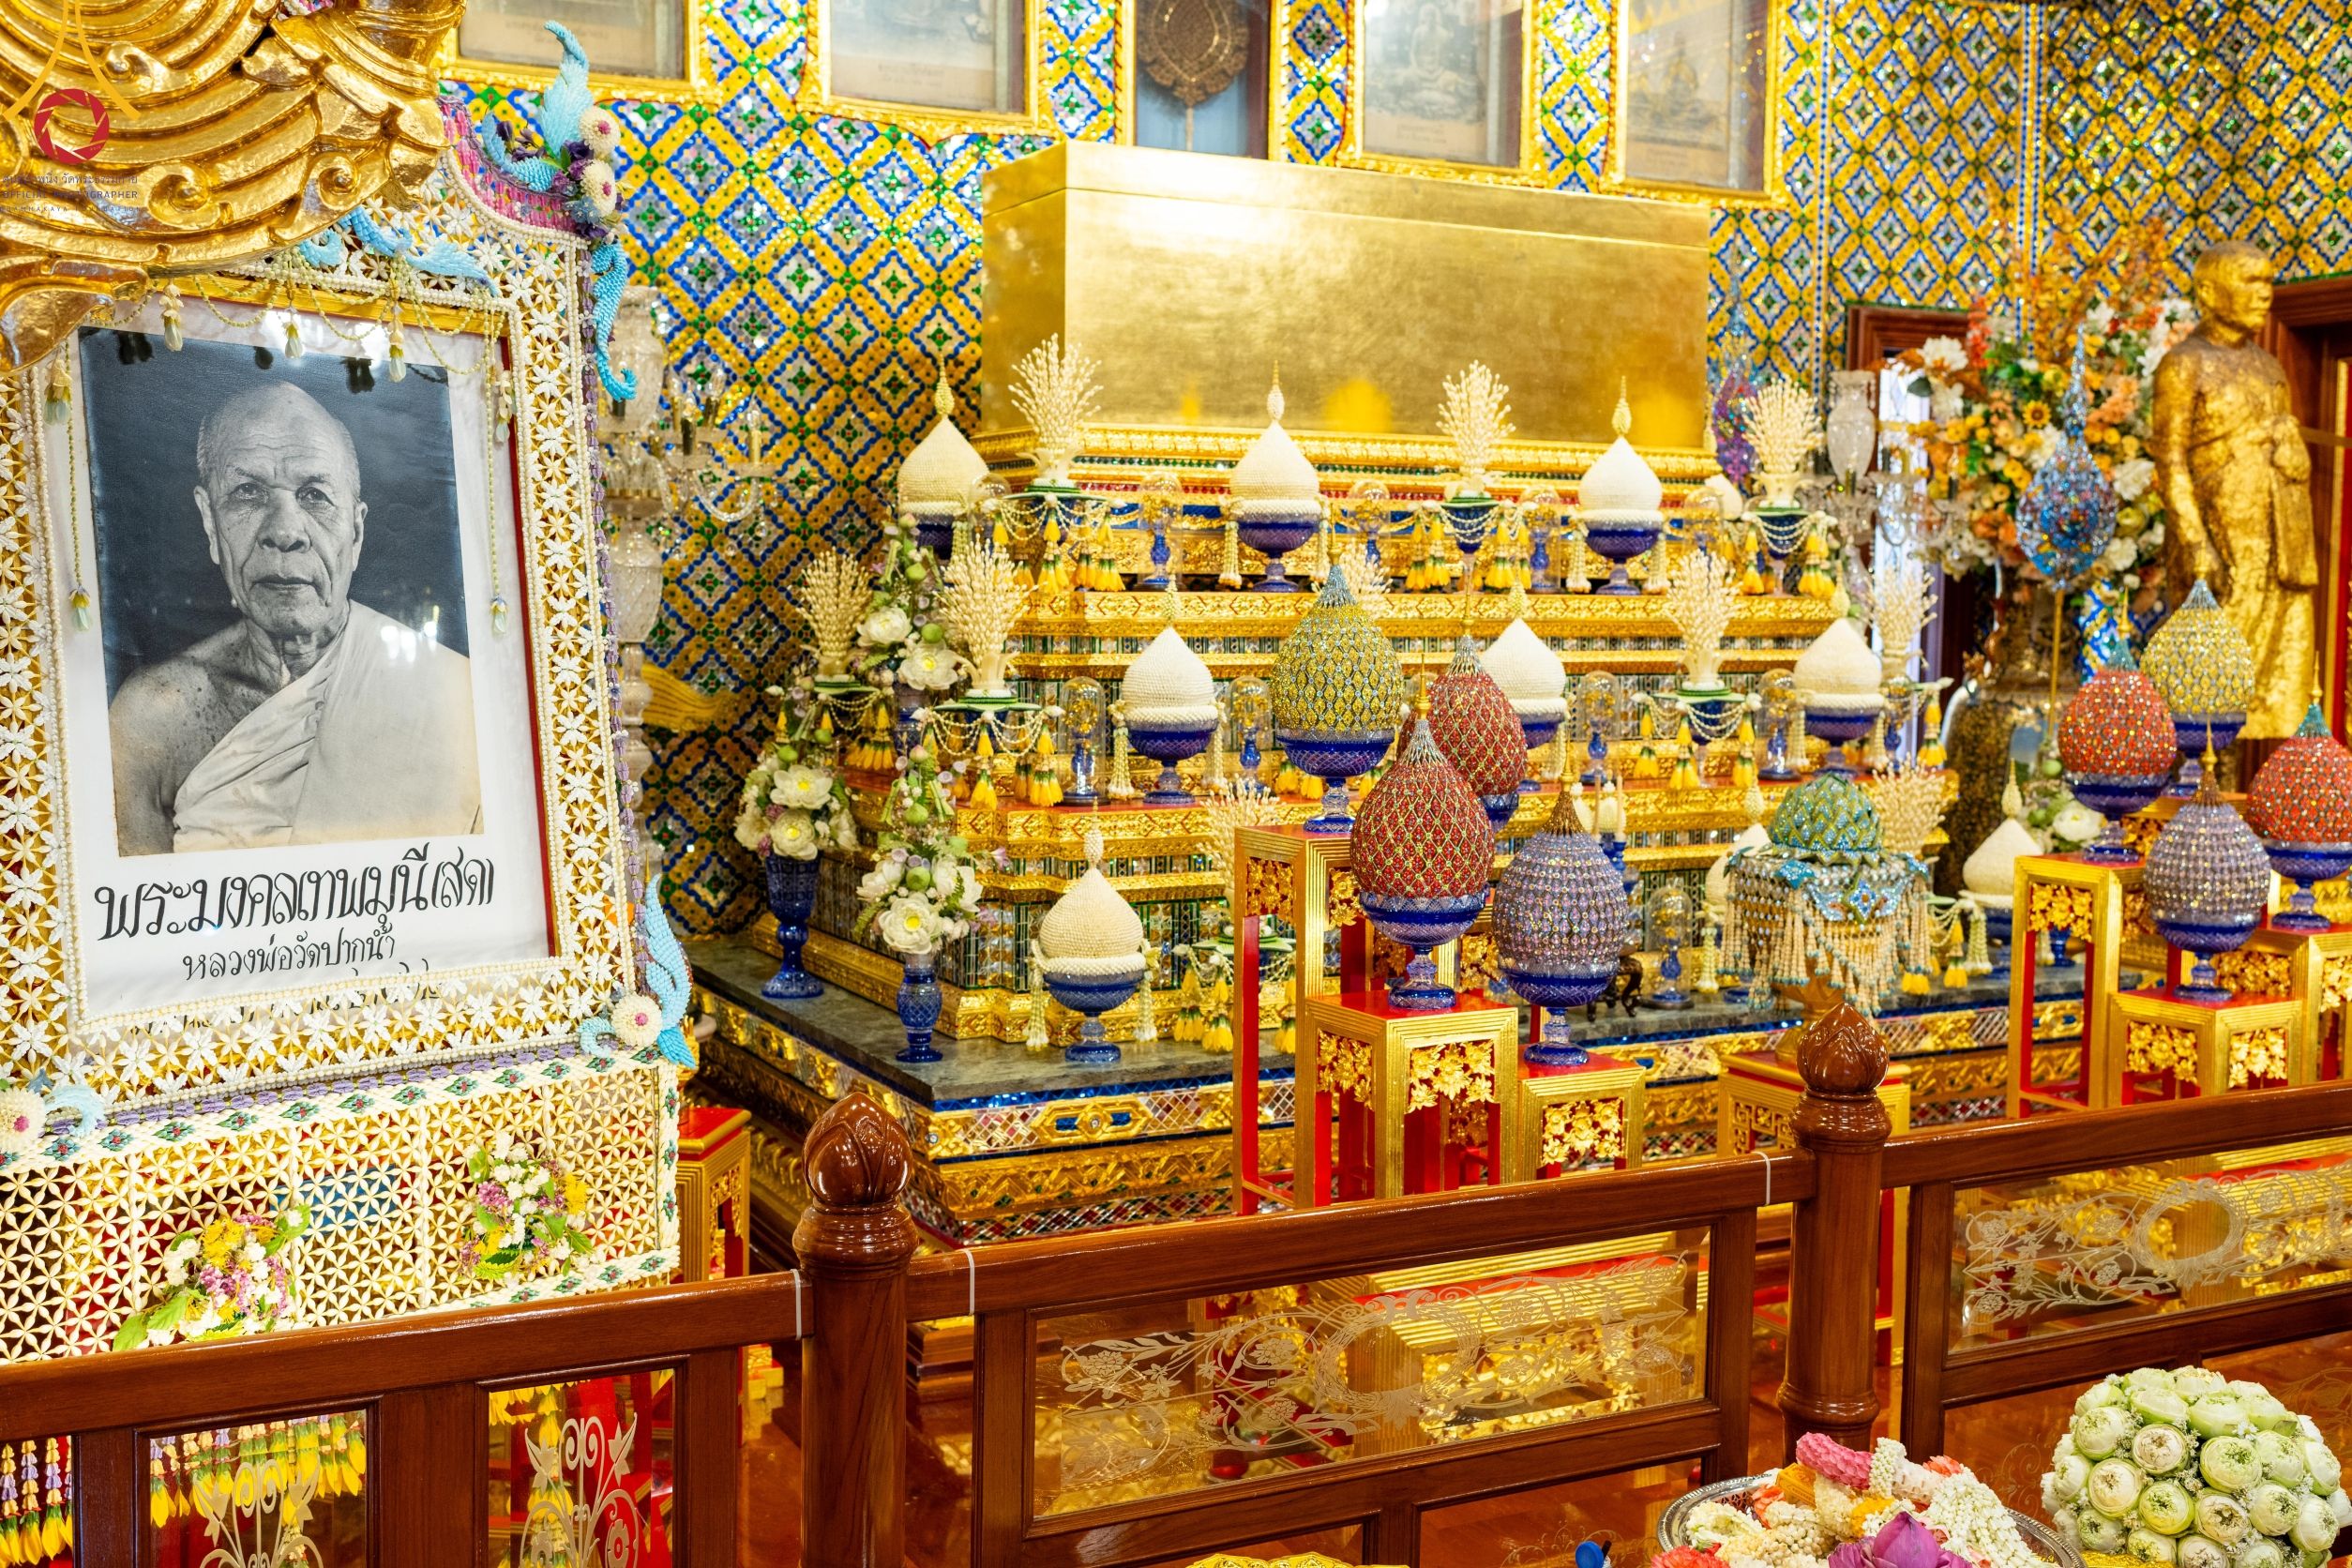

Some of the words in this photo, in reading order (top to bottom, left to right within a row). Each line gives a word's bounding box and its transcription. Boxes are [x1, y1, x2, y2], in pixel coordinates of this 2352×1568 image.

[182, 923, 396, 981] หลวงพ่อวัดปากน้ำ
